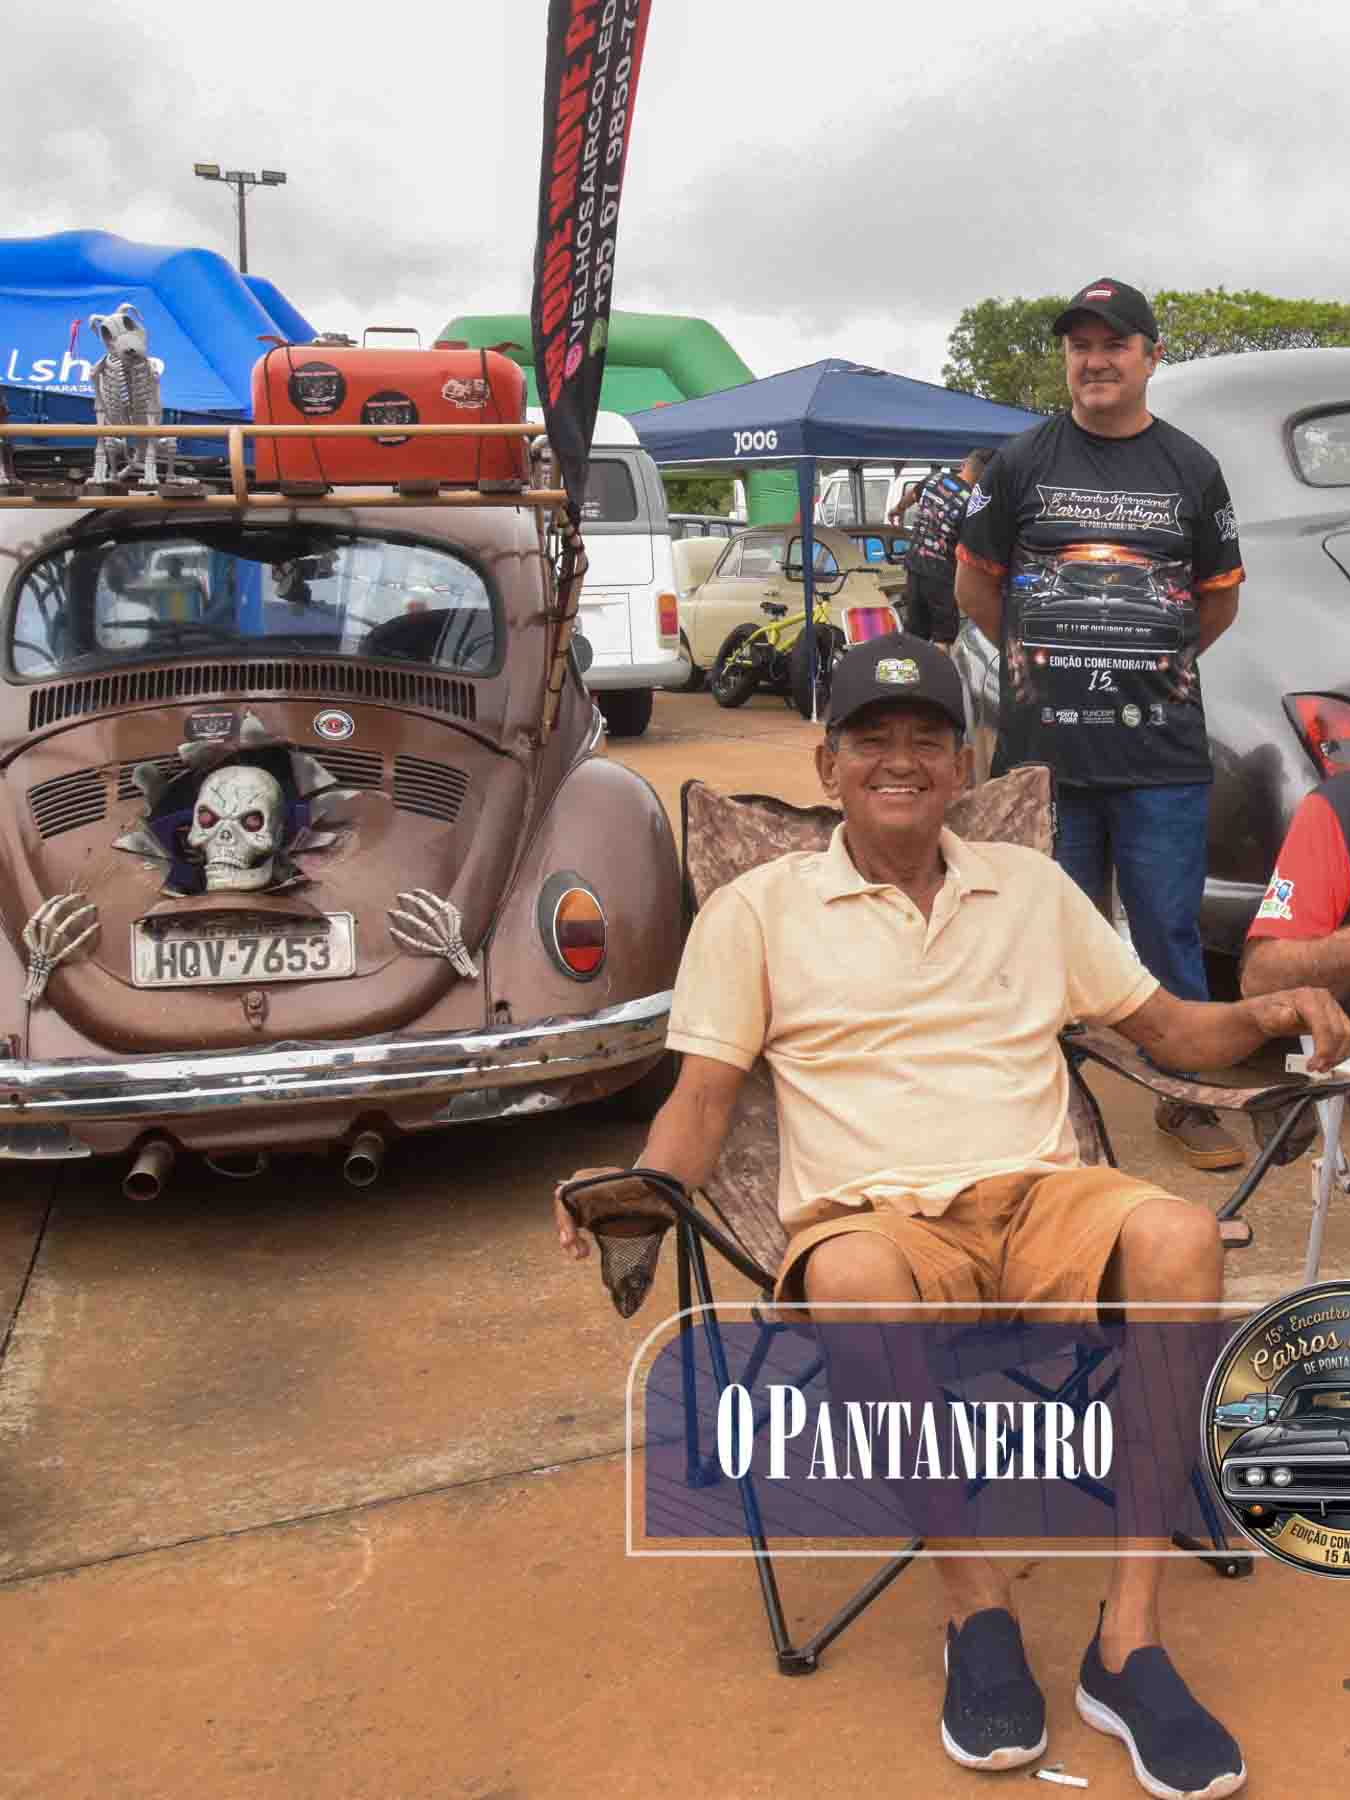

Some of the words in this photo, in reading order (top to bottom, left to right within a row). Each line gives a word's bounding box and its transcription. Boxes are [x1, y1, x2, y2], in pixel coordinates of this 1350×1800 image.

[549, 52, 593, 224] MOVE
[600, 183, 619, 230] 67
[542, 216, 573, 336] QUE
[594, 238, 615, 313] +55
[1050, 655, 1082, 669] EDIÇÃO
[1087, 669, 1112, 691] 15
